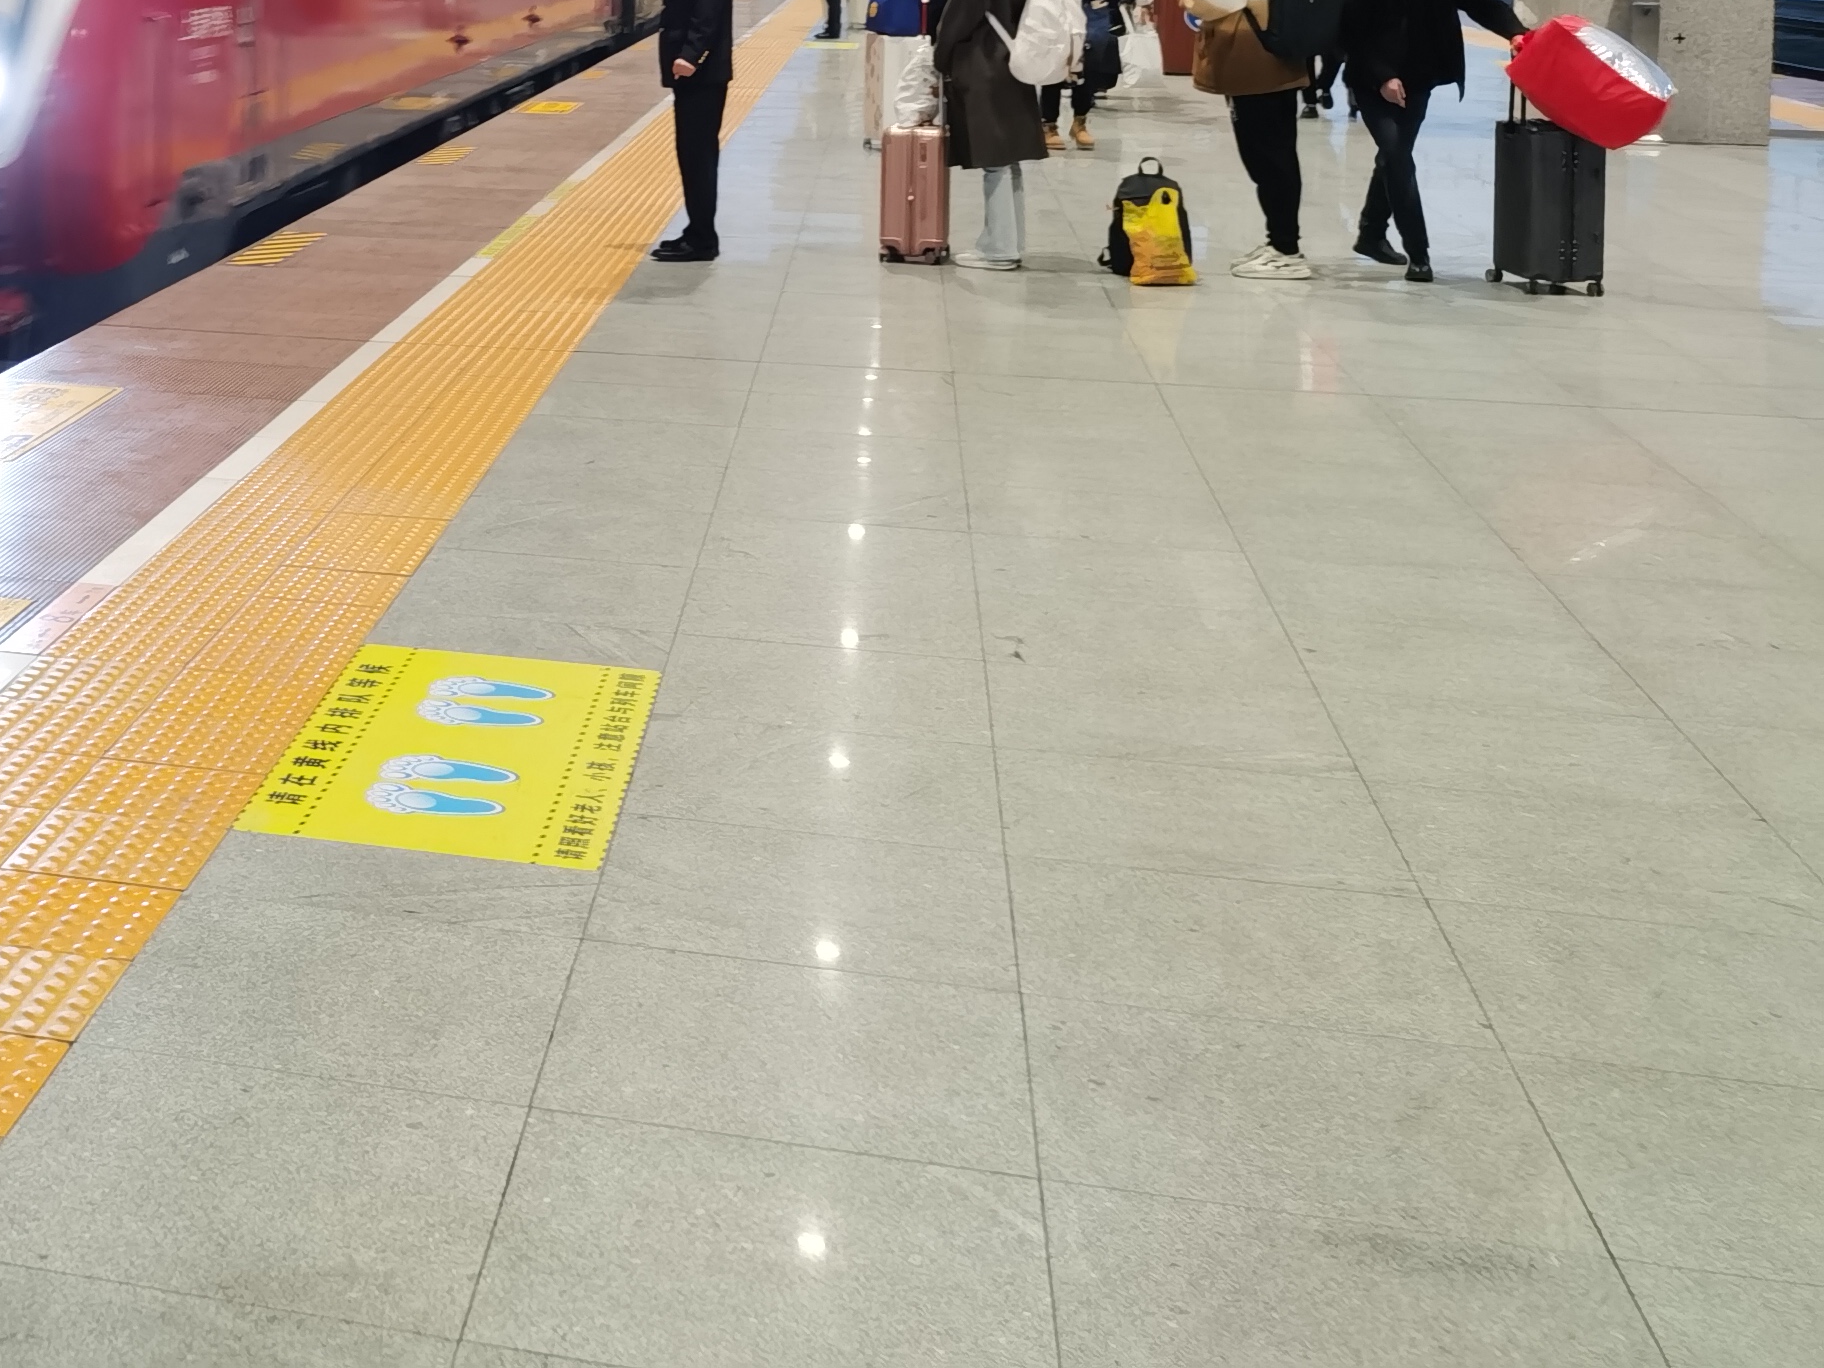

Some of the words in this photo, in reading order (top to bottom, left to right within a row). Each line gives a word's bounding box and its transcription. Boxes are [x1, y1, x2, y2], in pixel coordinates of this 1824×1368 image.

[264, 662, 394, 806] 请在黄线内排队等候
